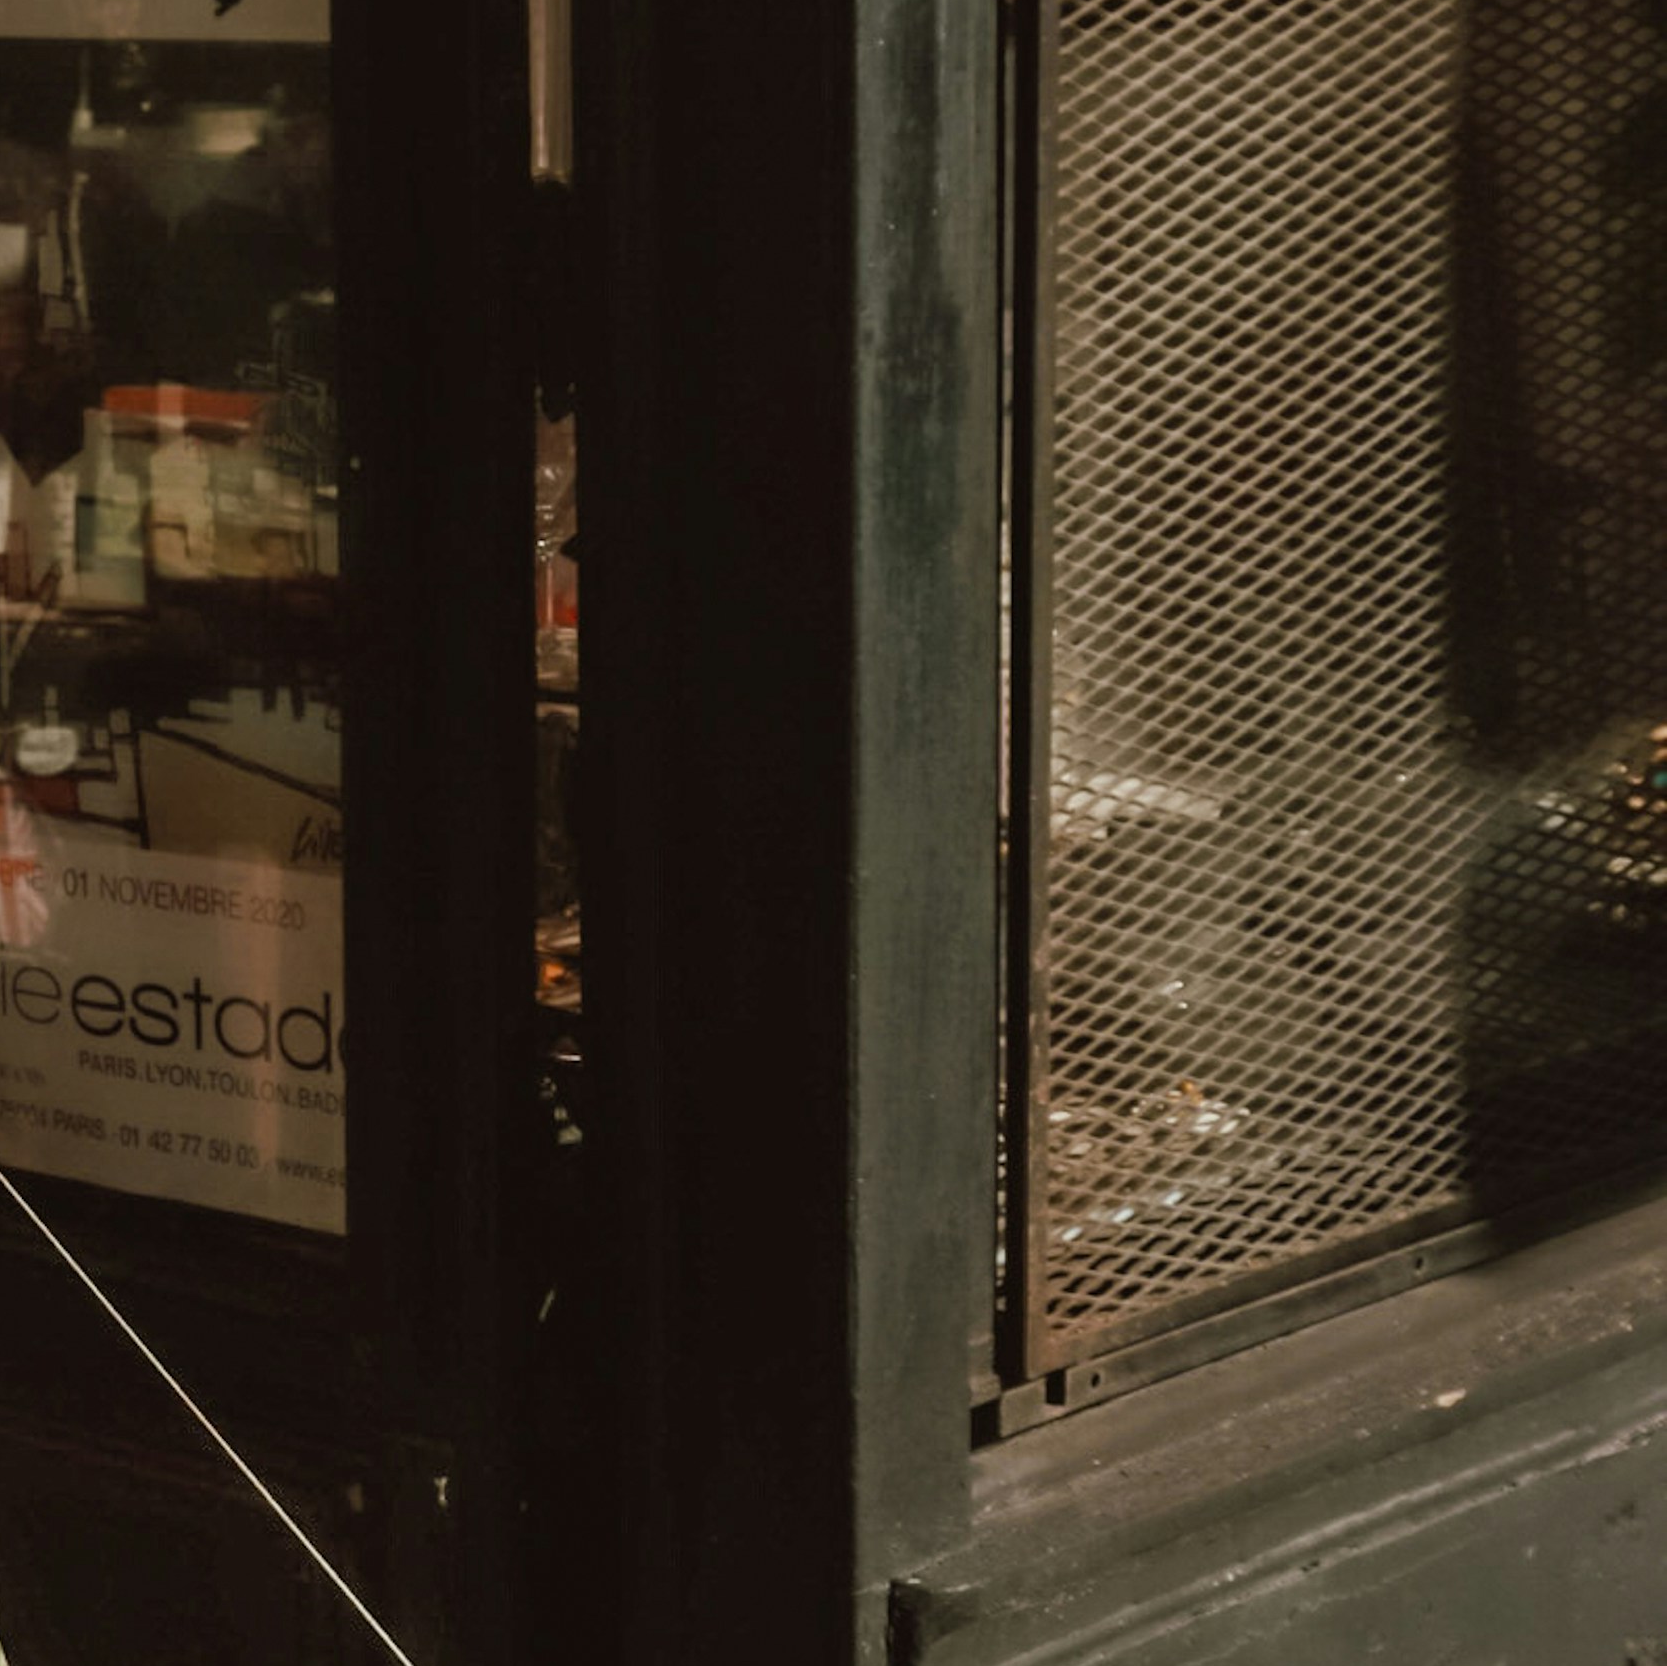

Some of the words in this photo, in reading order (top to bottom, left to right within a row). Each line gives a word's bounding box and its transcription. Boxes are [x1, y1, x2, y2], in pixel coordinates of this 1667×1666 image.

[62, 868, 89, 898] 01
[99, 874, 245, 920] NOVEMBRE
[249, 896, 305, 932] 2020
[51, 1107, 106, 1142] PARIS
[118, 1126, 141, 1150] 01
[148, 1131, 173, 1153] 42
[179, 1136, 202, 1159] 77
